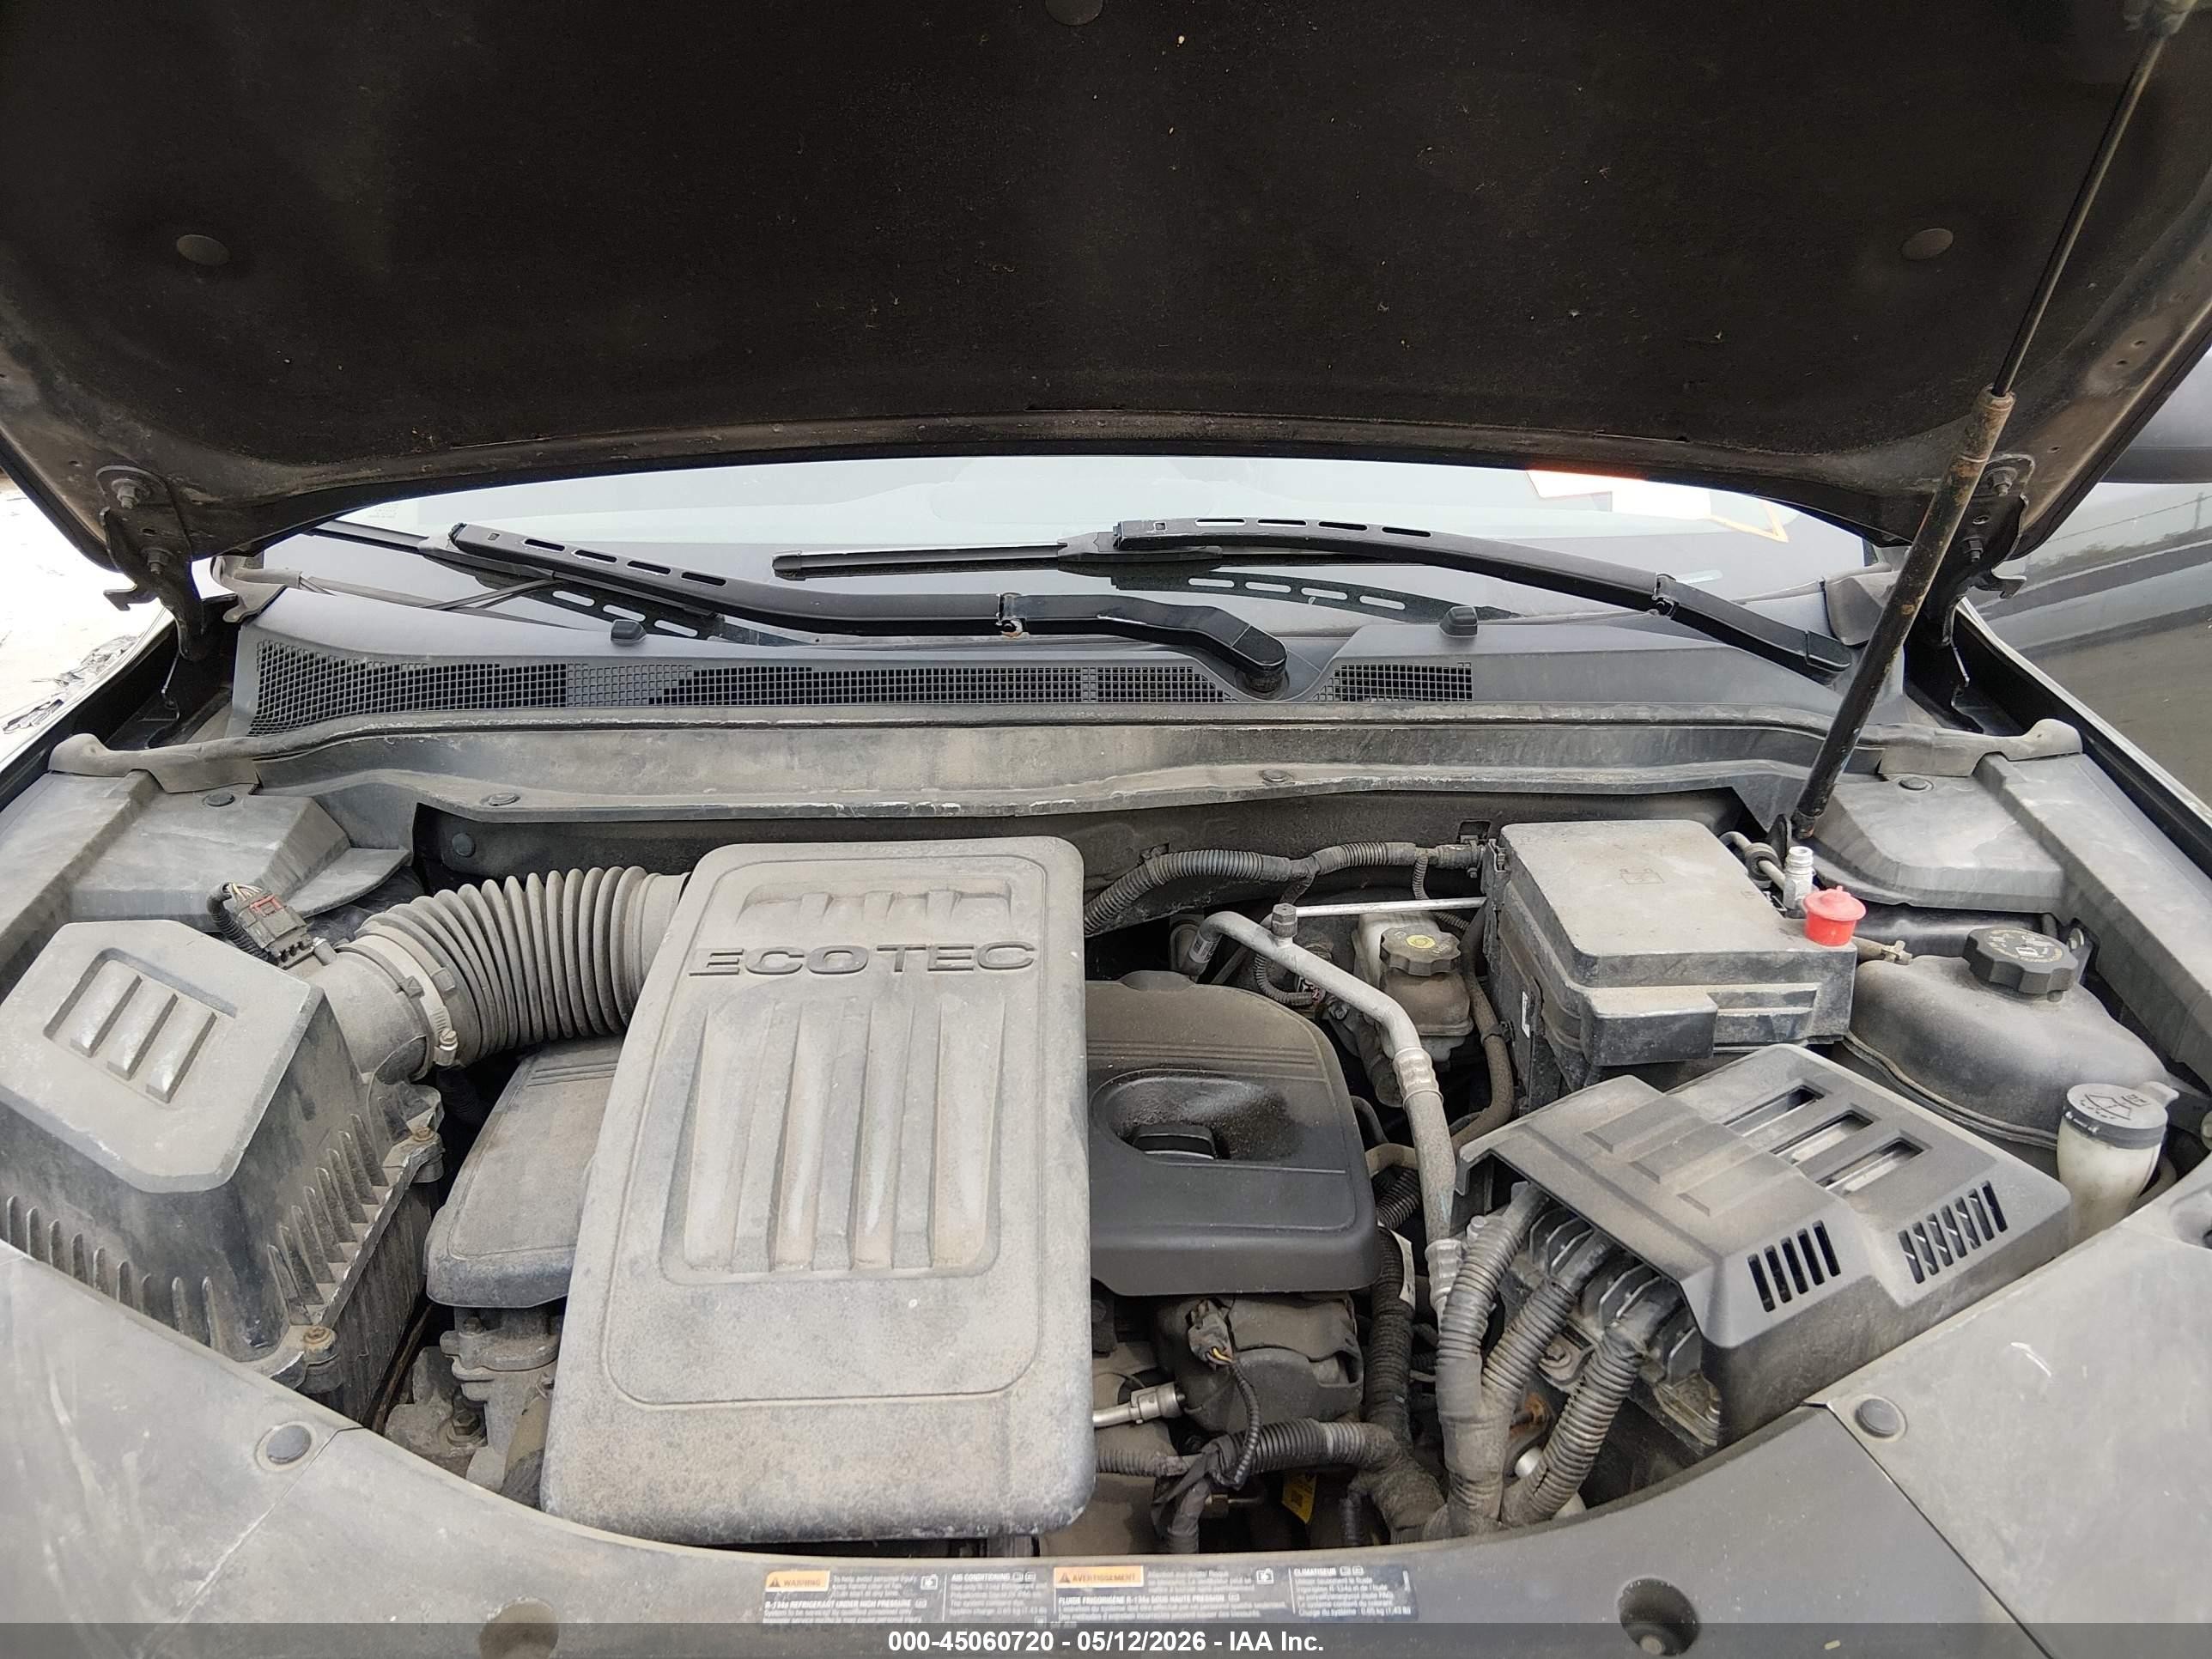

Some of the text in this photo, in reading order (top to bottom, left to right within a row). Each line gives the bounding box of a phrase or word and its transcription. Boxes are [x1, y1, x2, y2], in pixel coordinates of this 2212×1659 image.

[689, 940, 1036, 976] ECOTEC
[1073, 1572, 1136, 1582] AVERTISSEMENT
[783, 1578, 821, 1587] WARNING
